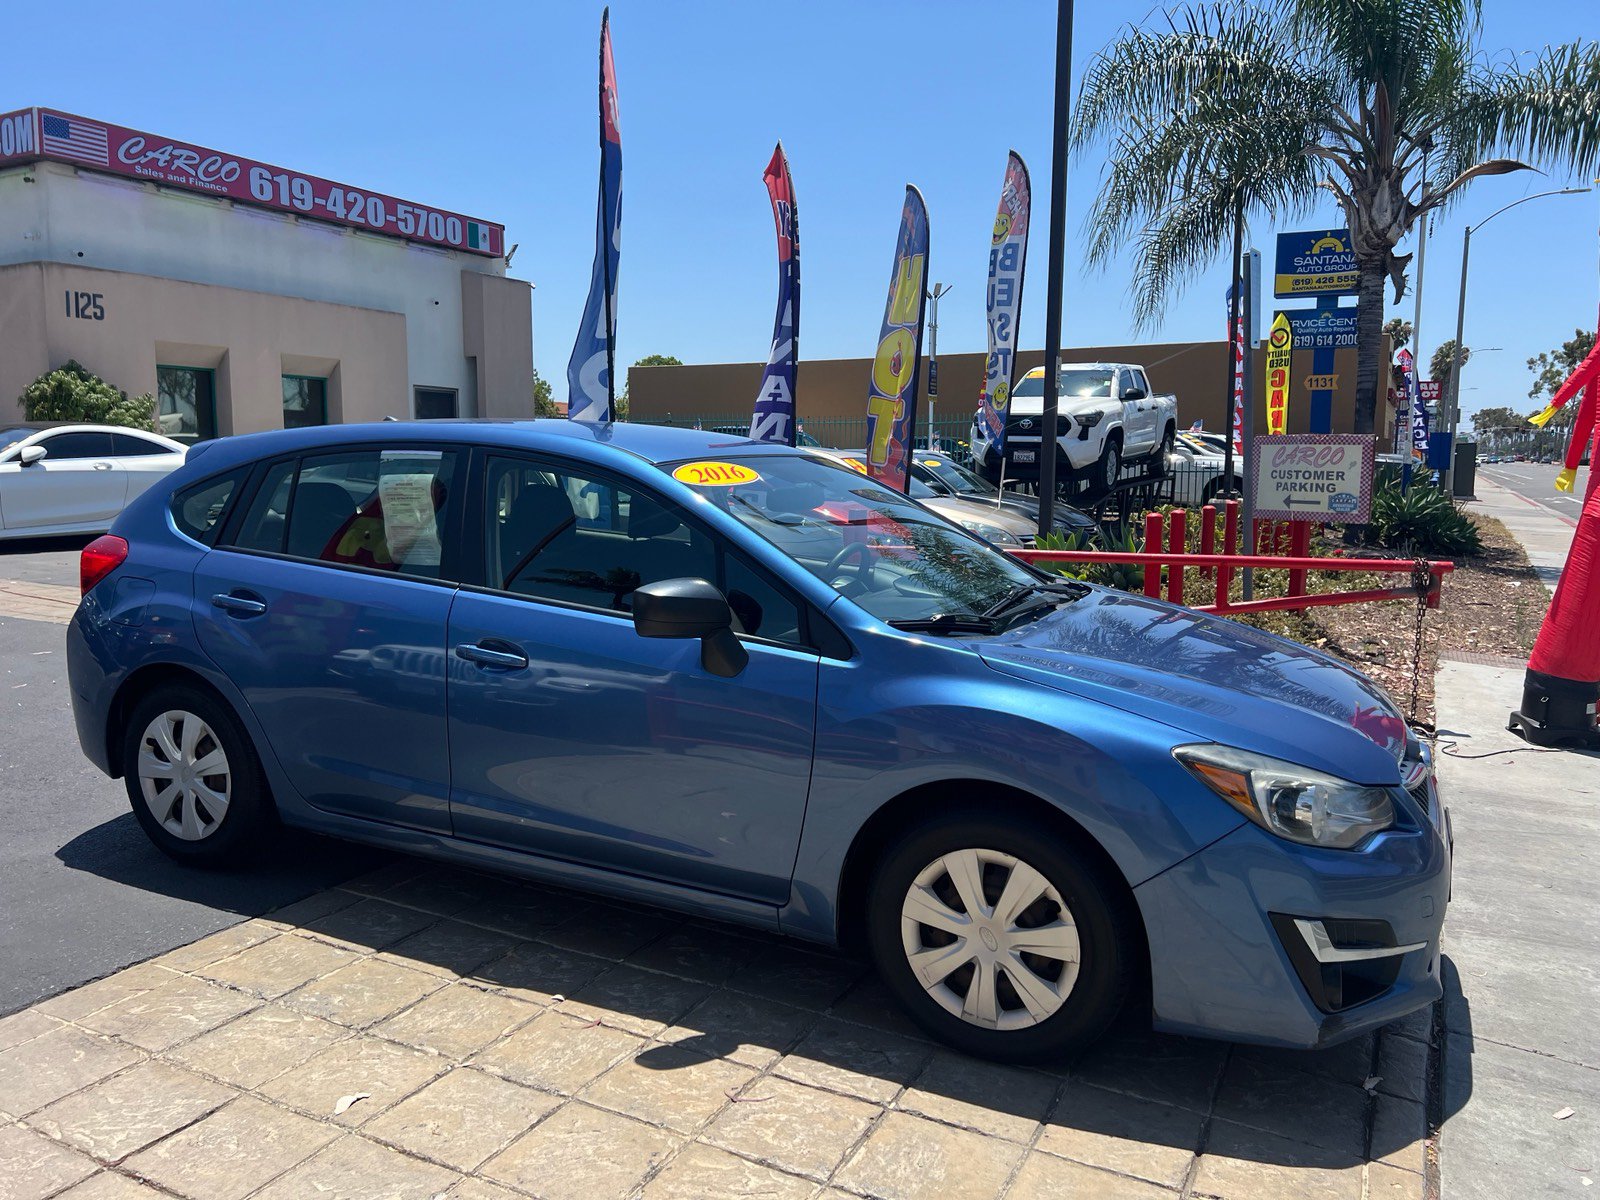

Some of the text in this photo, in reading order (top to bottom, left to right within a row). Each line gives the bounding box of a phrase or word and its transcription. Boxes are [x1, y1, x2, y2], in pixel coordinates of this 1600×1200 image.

[0, 113, 33, 157] OM
[117, 136, 241, 183] CARCO
[134, 165, 228, 193] Sales and Finance
[249, 166, 463, 245] 619-420-5700
[1296, 263, 1358, 273] AUTO GROUP
[1292, 277, 1313, 286] (619)
[1315, 276, 1335, 284] 426
[65, 290, 105, 321] 1125
[1290, 317, 1358, 328] RVICE CENT
[1316, 335, 1333, 346] 614
[867, 253, 924, 467] HOT
[1308, 377, 1334, 388] 1131
[1271, 446, 1346, 468] CARCO
[690, 466, 746, 484] 2016
[1270, 469, 1346, 481] CUSTOMER
[1275, 482, 1337, 493] PARKING
